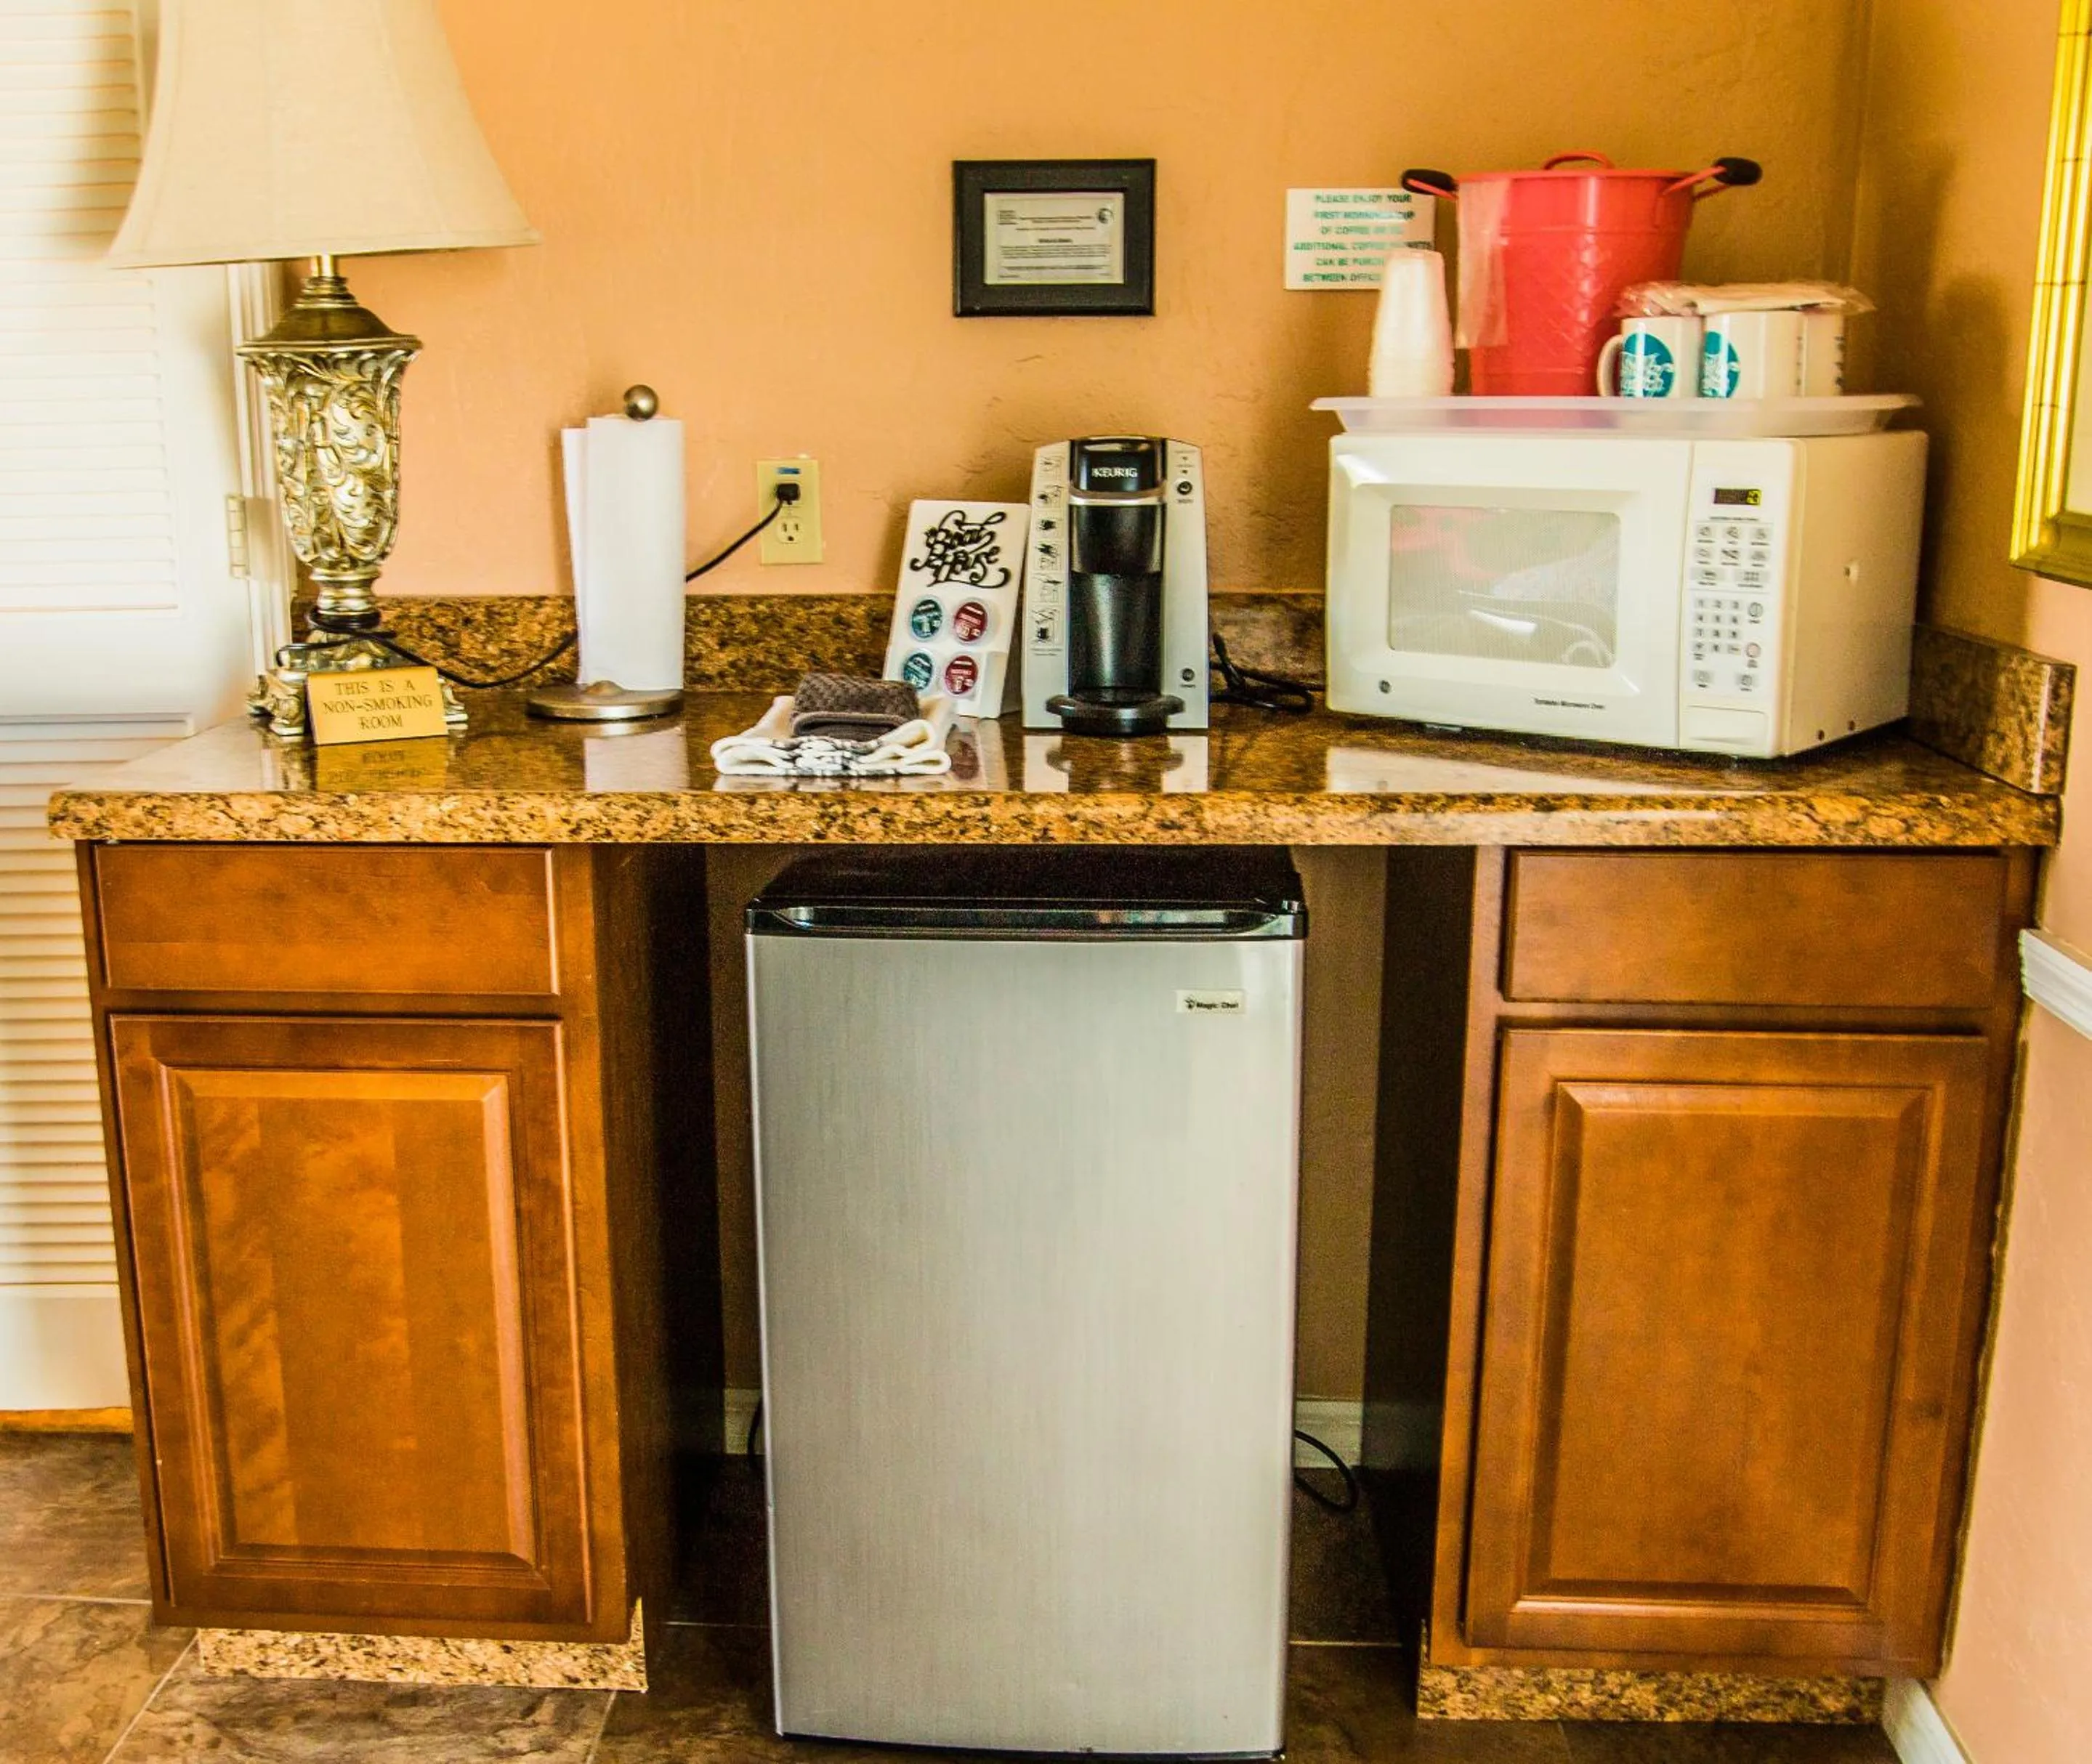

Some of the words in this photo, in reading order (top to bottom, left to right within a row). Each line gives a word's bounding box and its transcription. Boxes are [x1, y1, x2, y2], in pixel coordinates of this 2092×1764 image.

[1314, 194, 1349, 203] PLEASE
[1387, 194, 1413, 203] YOUR
[1091, 467, 1139, 477] KEURIG
[334, 680, 371, 695] THIS
[379, 680, 395, 692] IS
[405, 679, 416, 691] A
[323, 695, 433, 715] NON-SMOKING
[358, 714, 403, 730] ROOM
